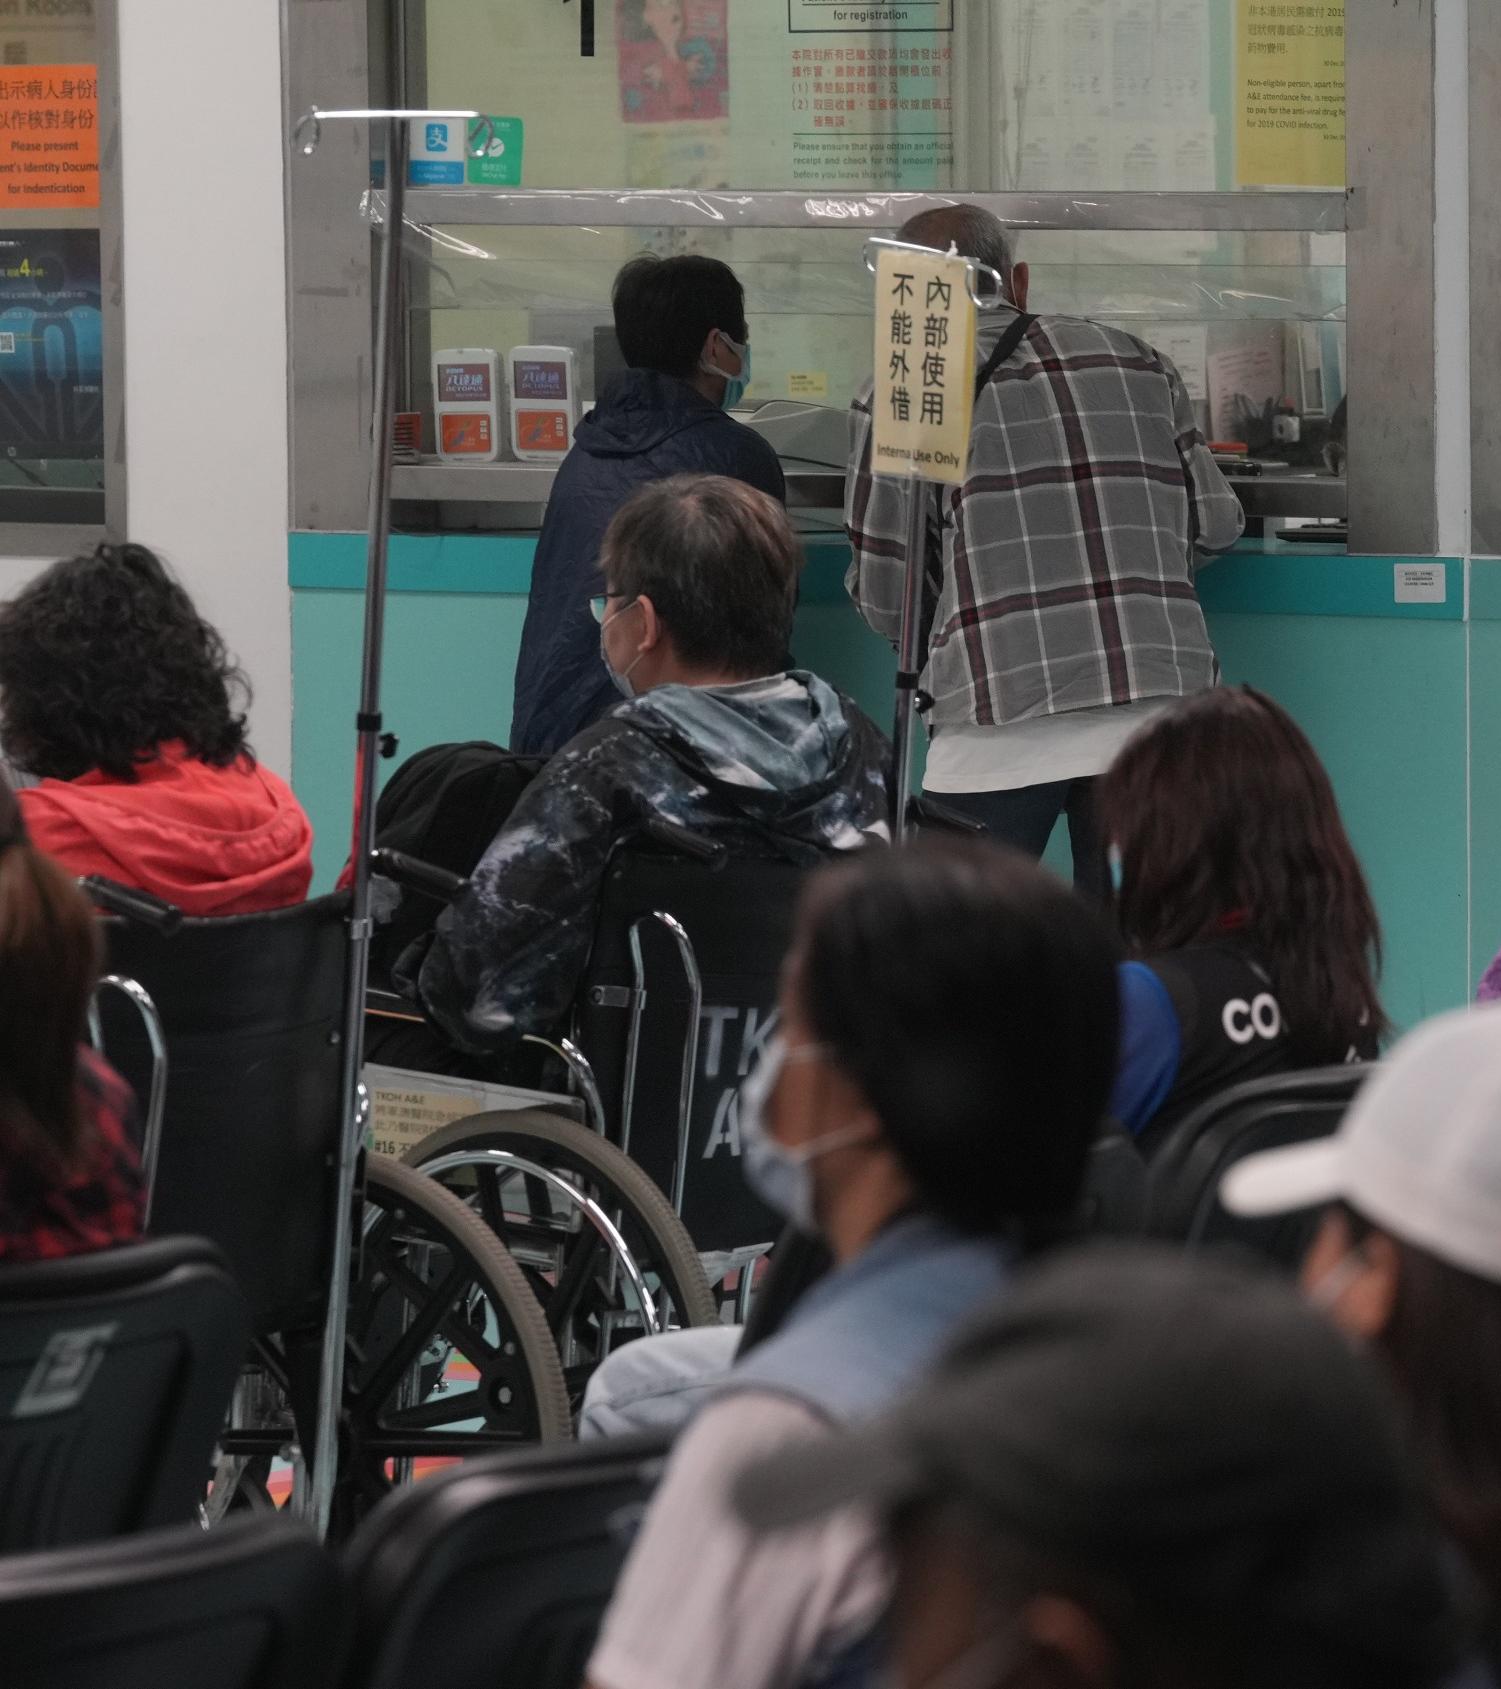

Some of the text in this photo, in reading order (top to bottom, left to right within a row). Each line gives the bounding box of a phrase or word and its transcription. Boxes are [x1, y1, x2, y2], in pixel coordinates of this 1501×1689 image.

[834, 9, 908, 22] for registration
[11, 140, 79, 153] Please present
[0, 162, 99, 175] ent's Identity Docume
[8, 183, 21, 194] for
[889, 272, 915, 422] 不能外借
[919, 275, 951, 426] 內部使用
[877, 443, 960, 469] Interna Use Only
[701, 1006, 781, 1076] TK
